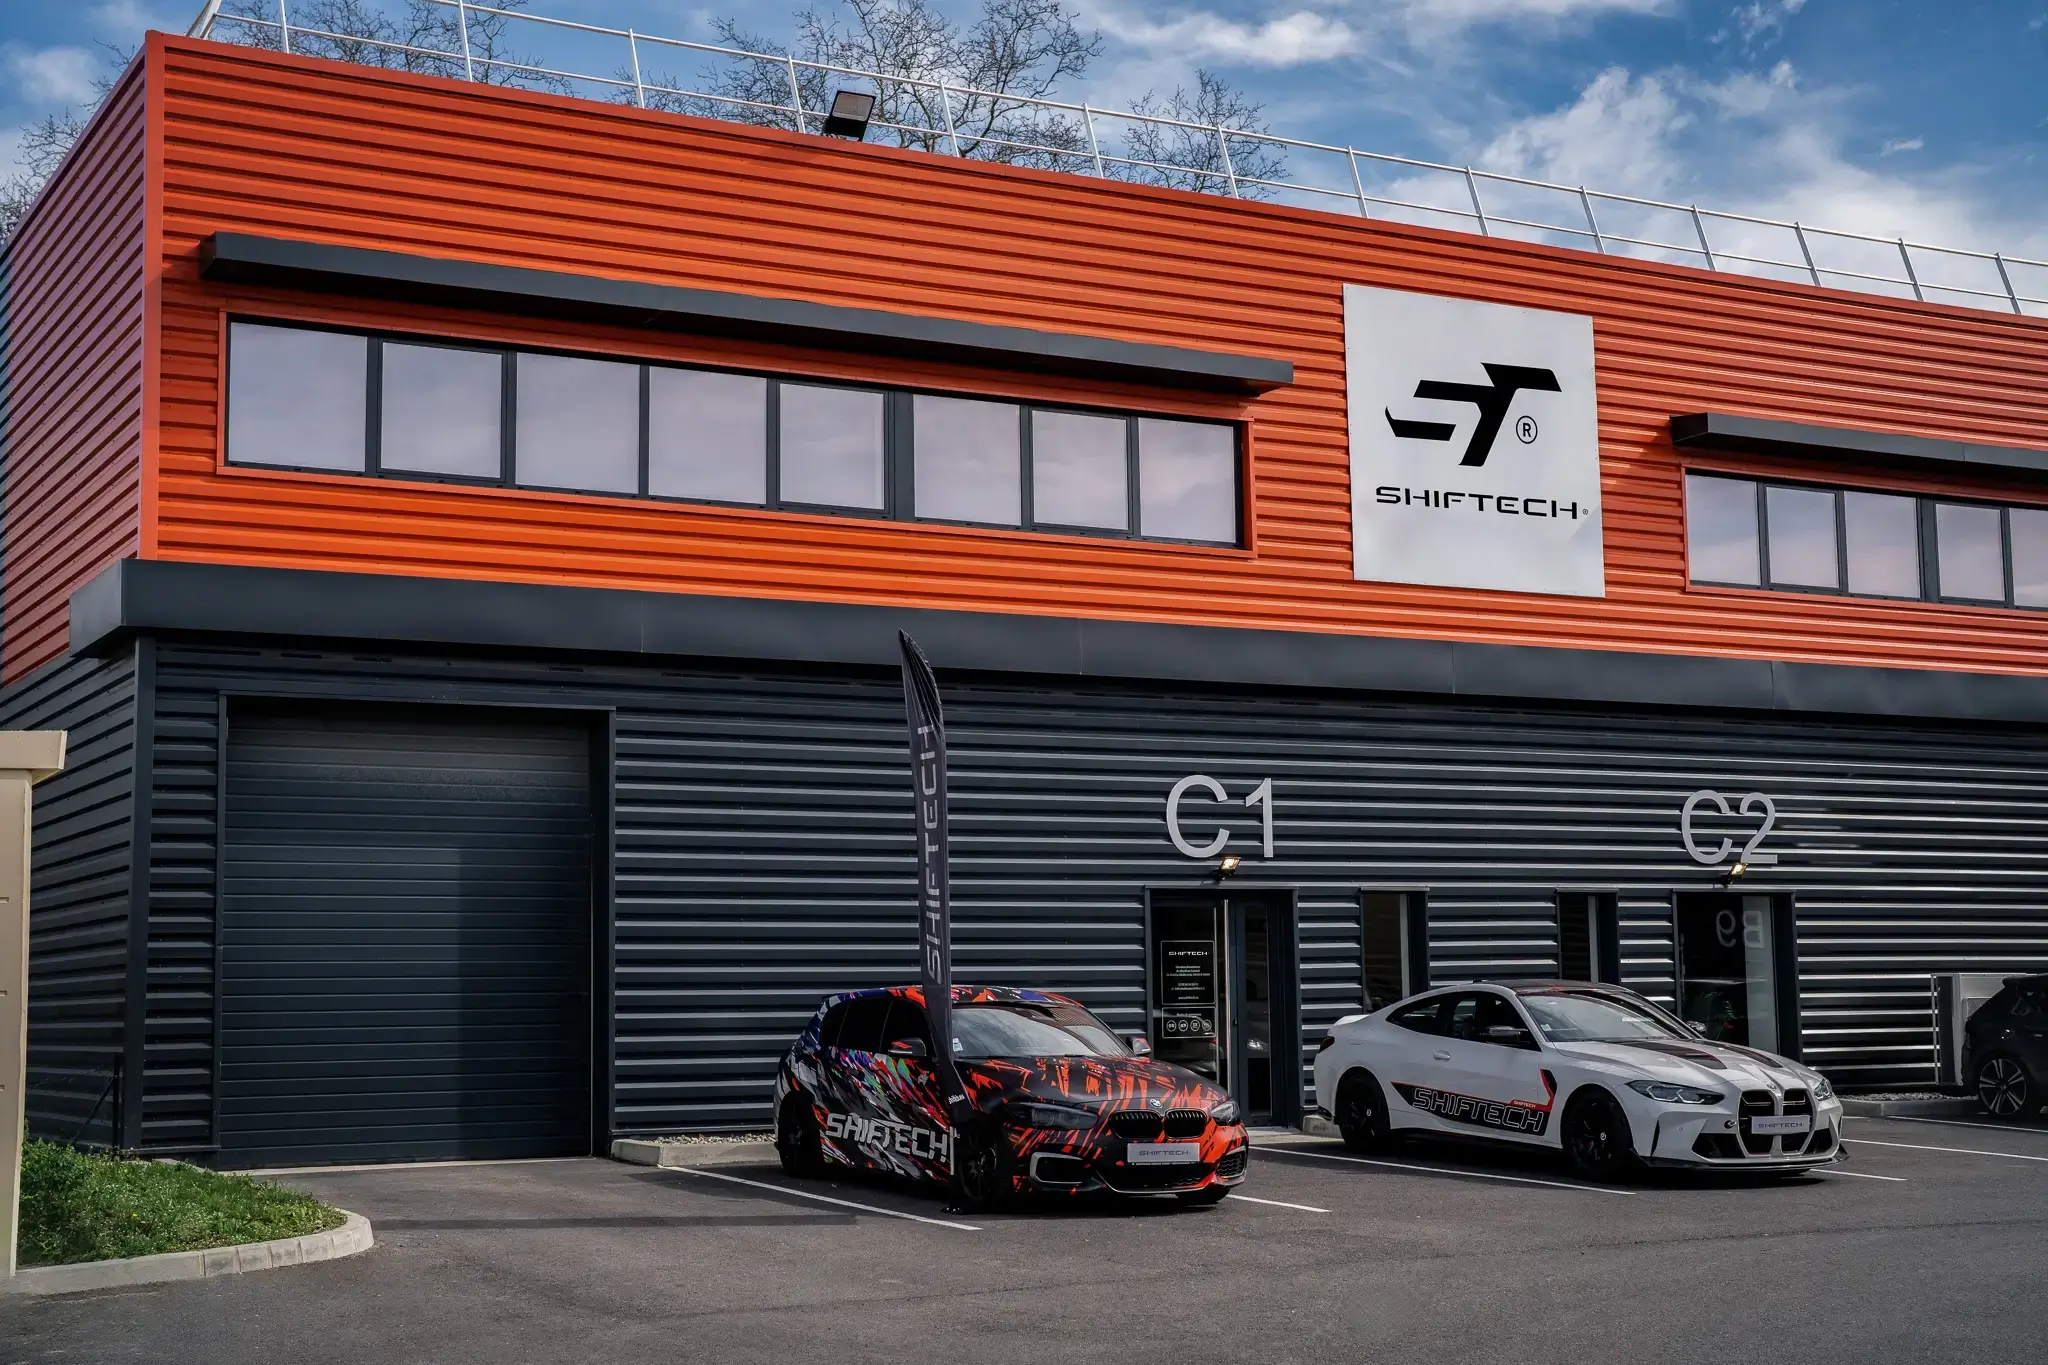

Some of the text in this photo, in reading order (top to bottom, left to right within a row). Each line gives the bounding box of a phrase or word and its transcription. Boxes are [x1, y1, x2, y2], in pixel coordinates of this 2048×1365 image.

[1166, 775, 1274, 858] C1
[1681, 790, 1778, 864] C2
[917, 724, 942, 985] SHIFTECH
[825, 1113, 948, 1163] SHIFTECH
[1413, 1088, 1544, 1132] SHIFTECH
